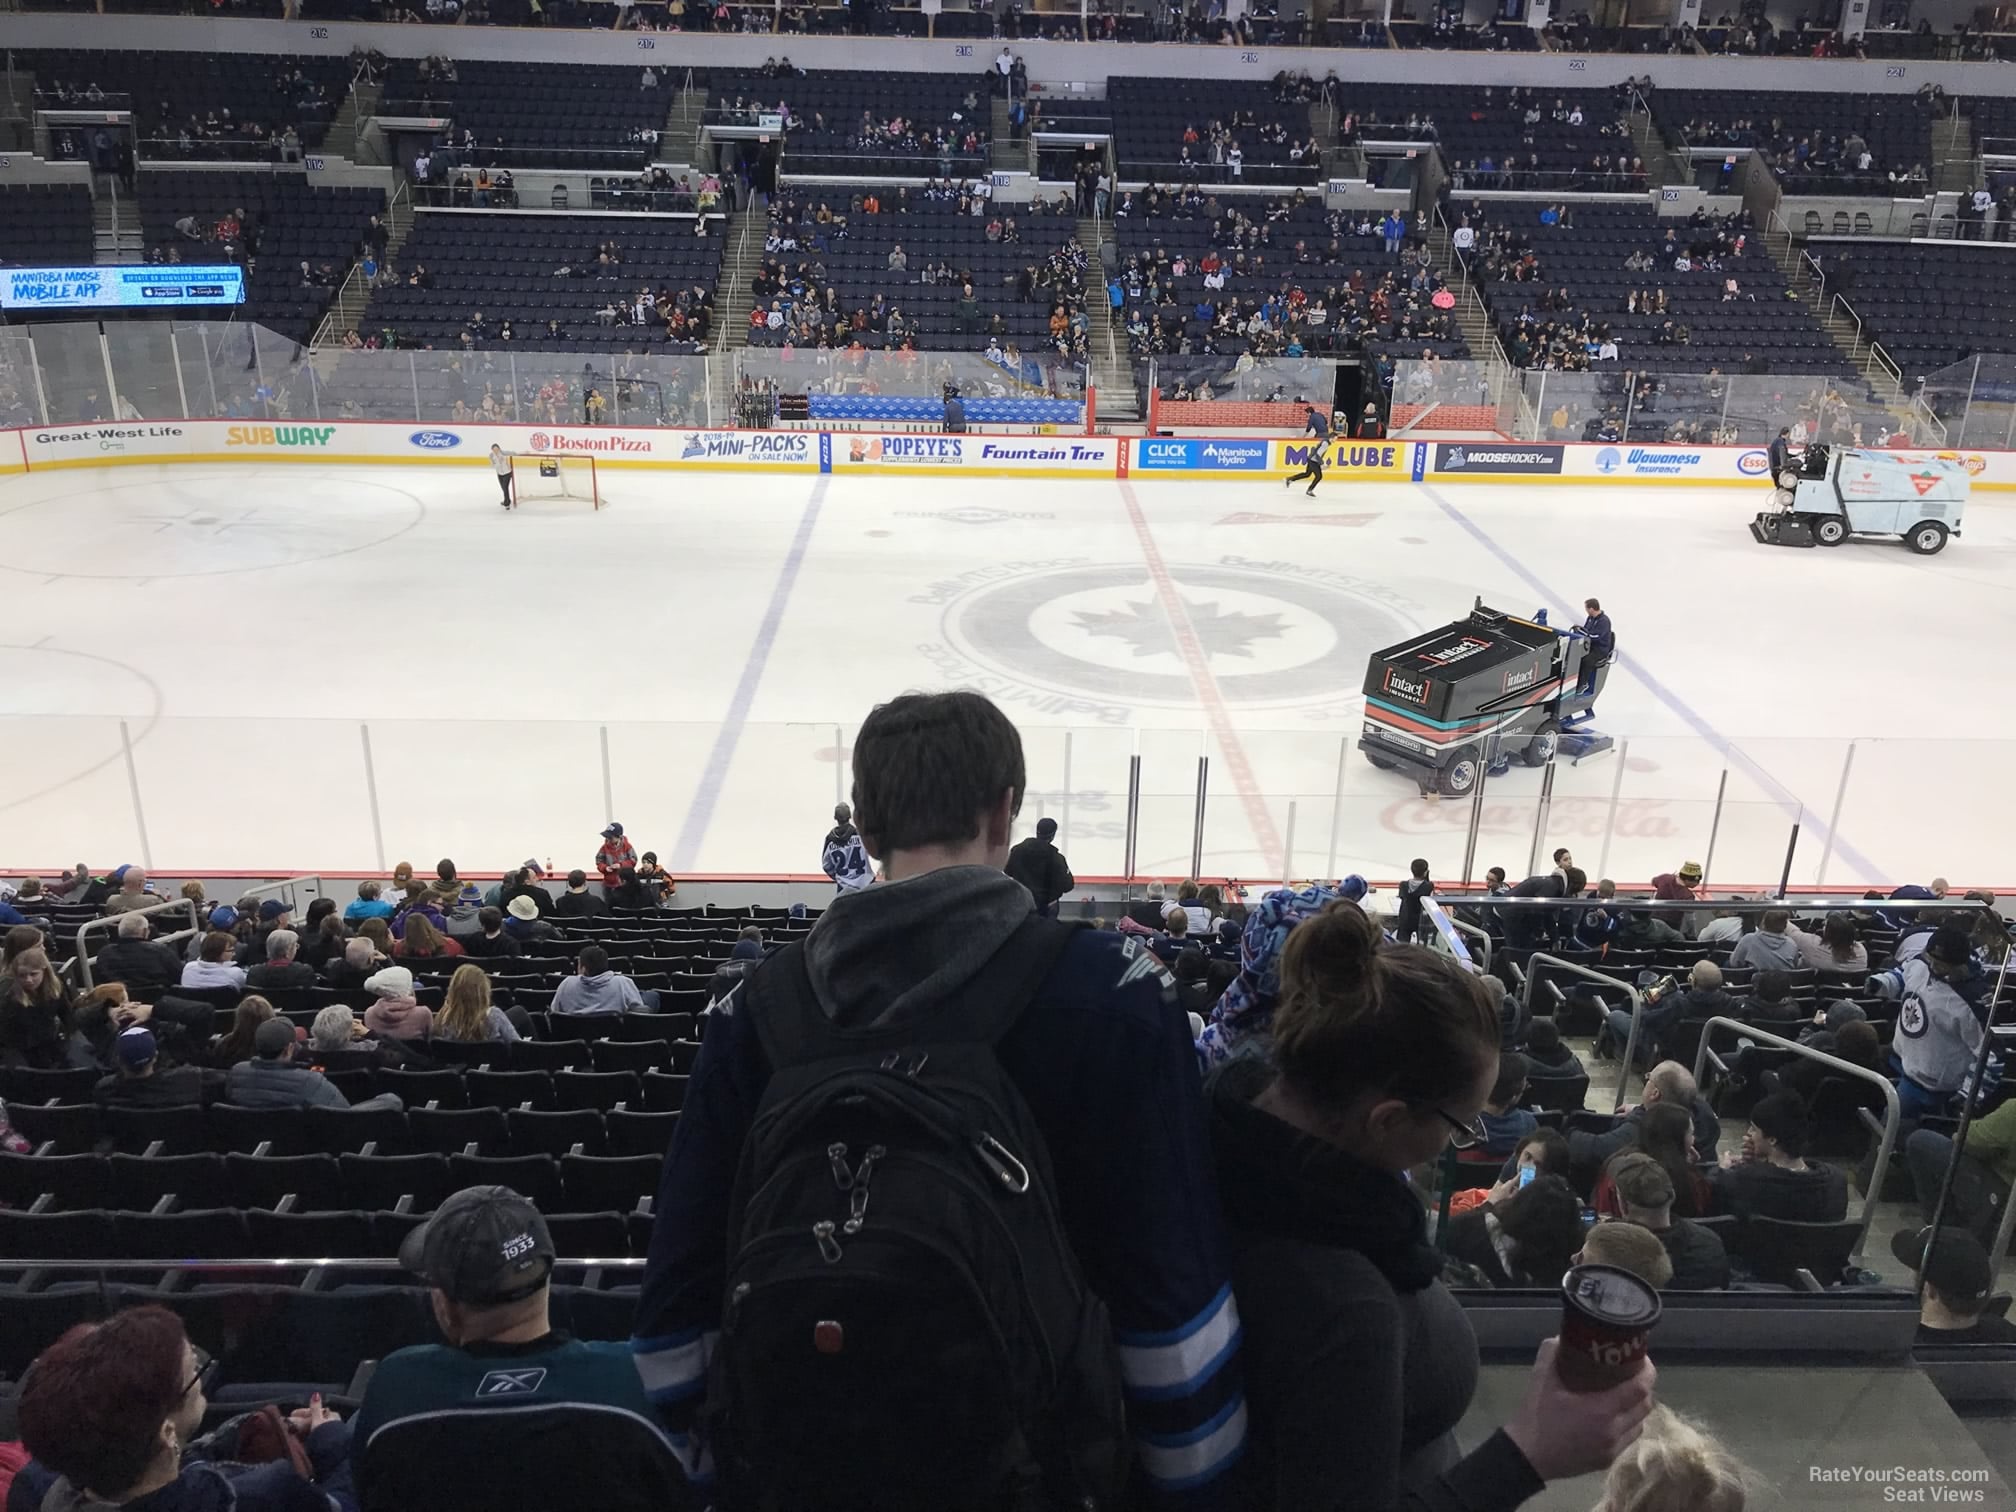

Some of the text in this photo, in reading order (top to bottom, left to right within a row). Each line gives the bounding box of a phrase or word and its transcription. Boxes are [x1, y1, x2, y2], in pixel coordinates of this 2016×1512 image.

[311, 28, 328, 38] 216
[638, 39, 655, 49] 217
[956, 46, 972, 56] 218
[1241, 53, 1258, 63] 219
[1569, 60, 1586, 70] 220
[61, 142, 73, 153] 15
[306, 160, 324, 170] 116
[992, 176, 1010, 186] 118
[1329, 183, 1346, 193] 119
[1662, 190, 1679, 201] 120
[11, 271, 101, 284] MANITOBA MOOSE
[13, 283, 101, 300] MOBILE APP
[36, 427, 183, 444] Great-West Life
[225, 426, 336, 446] SUBWAY
[419, 431, 451, 448] Ford
[703, 432, 735, 442] 2018-19
[707, 434, 808, 457] MINI-PACKS
[881, 437, 962, 457] POPEYE'S
[1148, 444, 1188, 457] CLICK
[748, 451, 808, 462] ON SALE NOW!
[982, 445, 1105, 461] Fountain Tire
[1218, 447, 1263, 457] Manitoba
[1337, 446, 1395, 467] LUBE
[1627, 449, 1701, 465] Wawanesa
[1217, 456, 1246, 466] Hydro
[1743, 456, 1767, 468] Esso
[1635, 464, 1681, 474] Insurance
[1429, 640, 1479, 660] intact
[1507, 668, 1533, 686] intact
[1390, 673, 1424, 697] intact
[831, 846, 866, 876] 24
[501, 1237, 535, 1260] 1933
